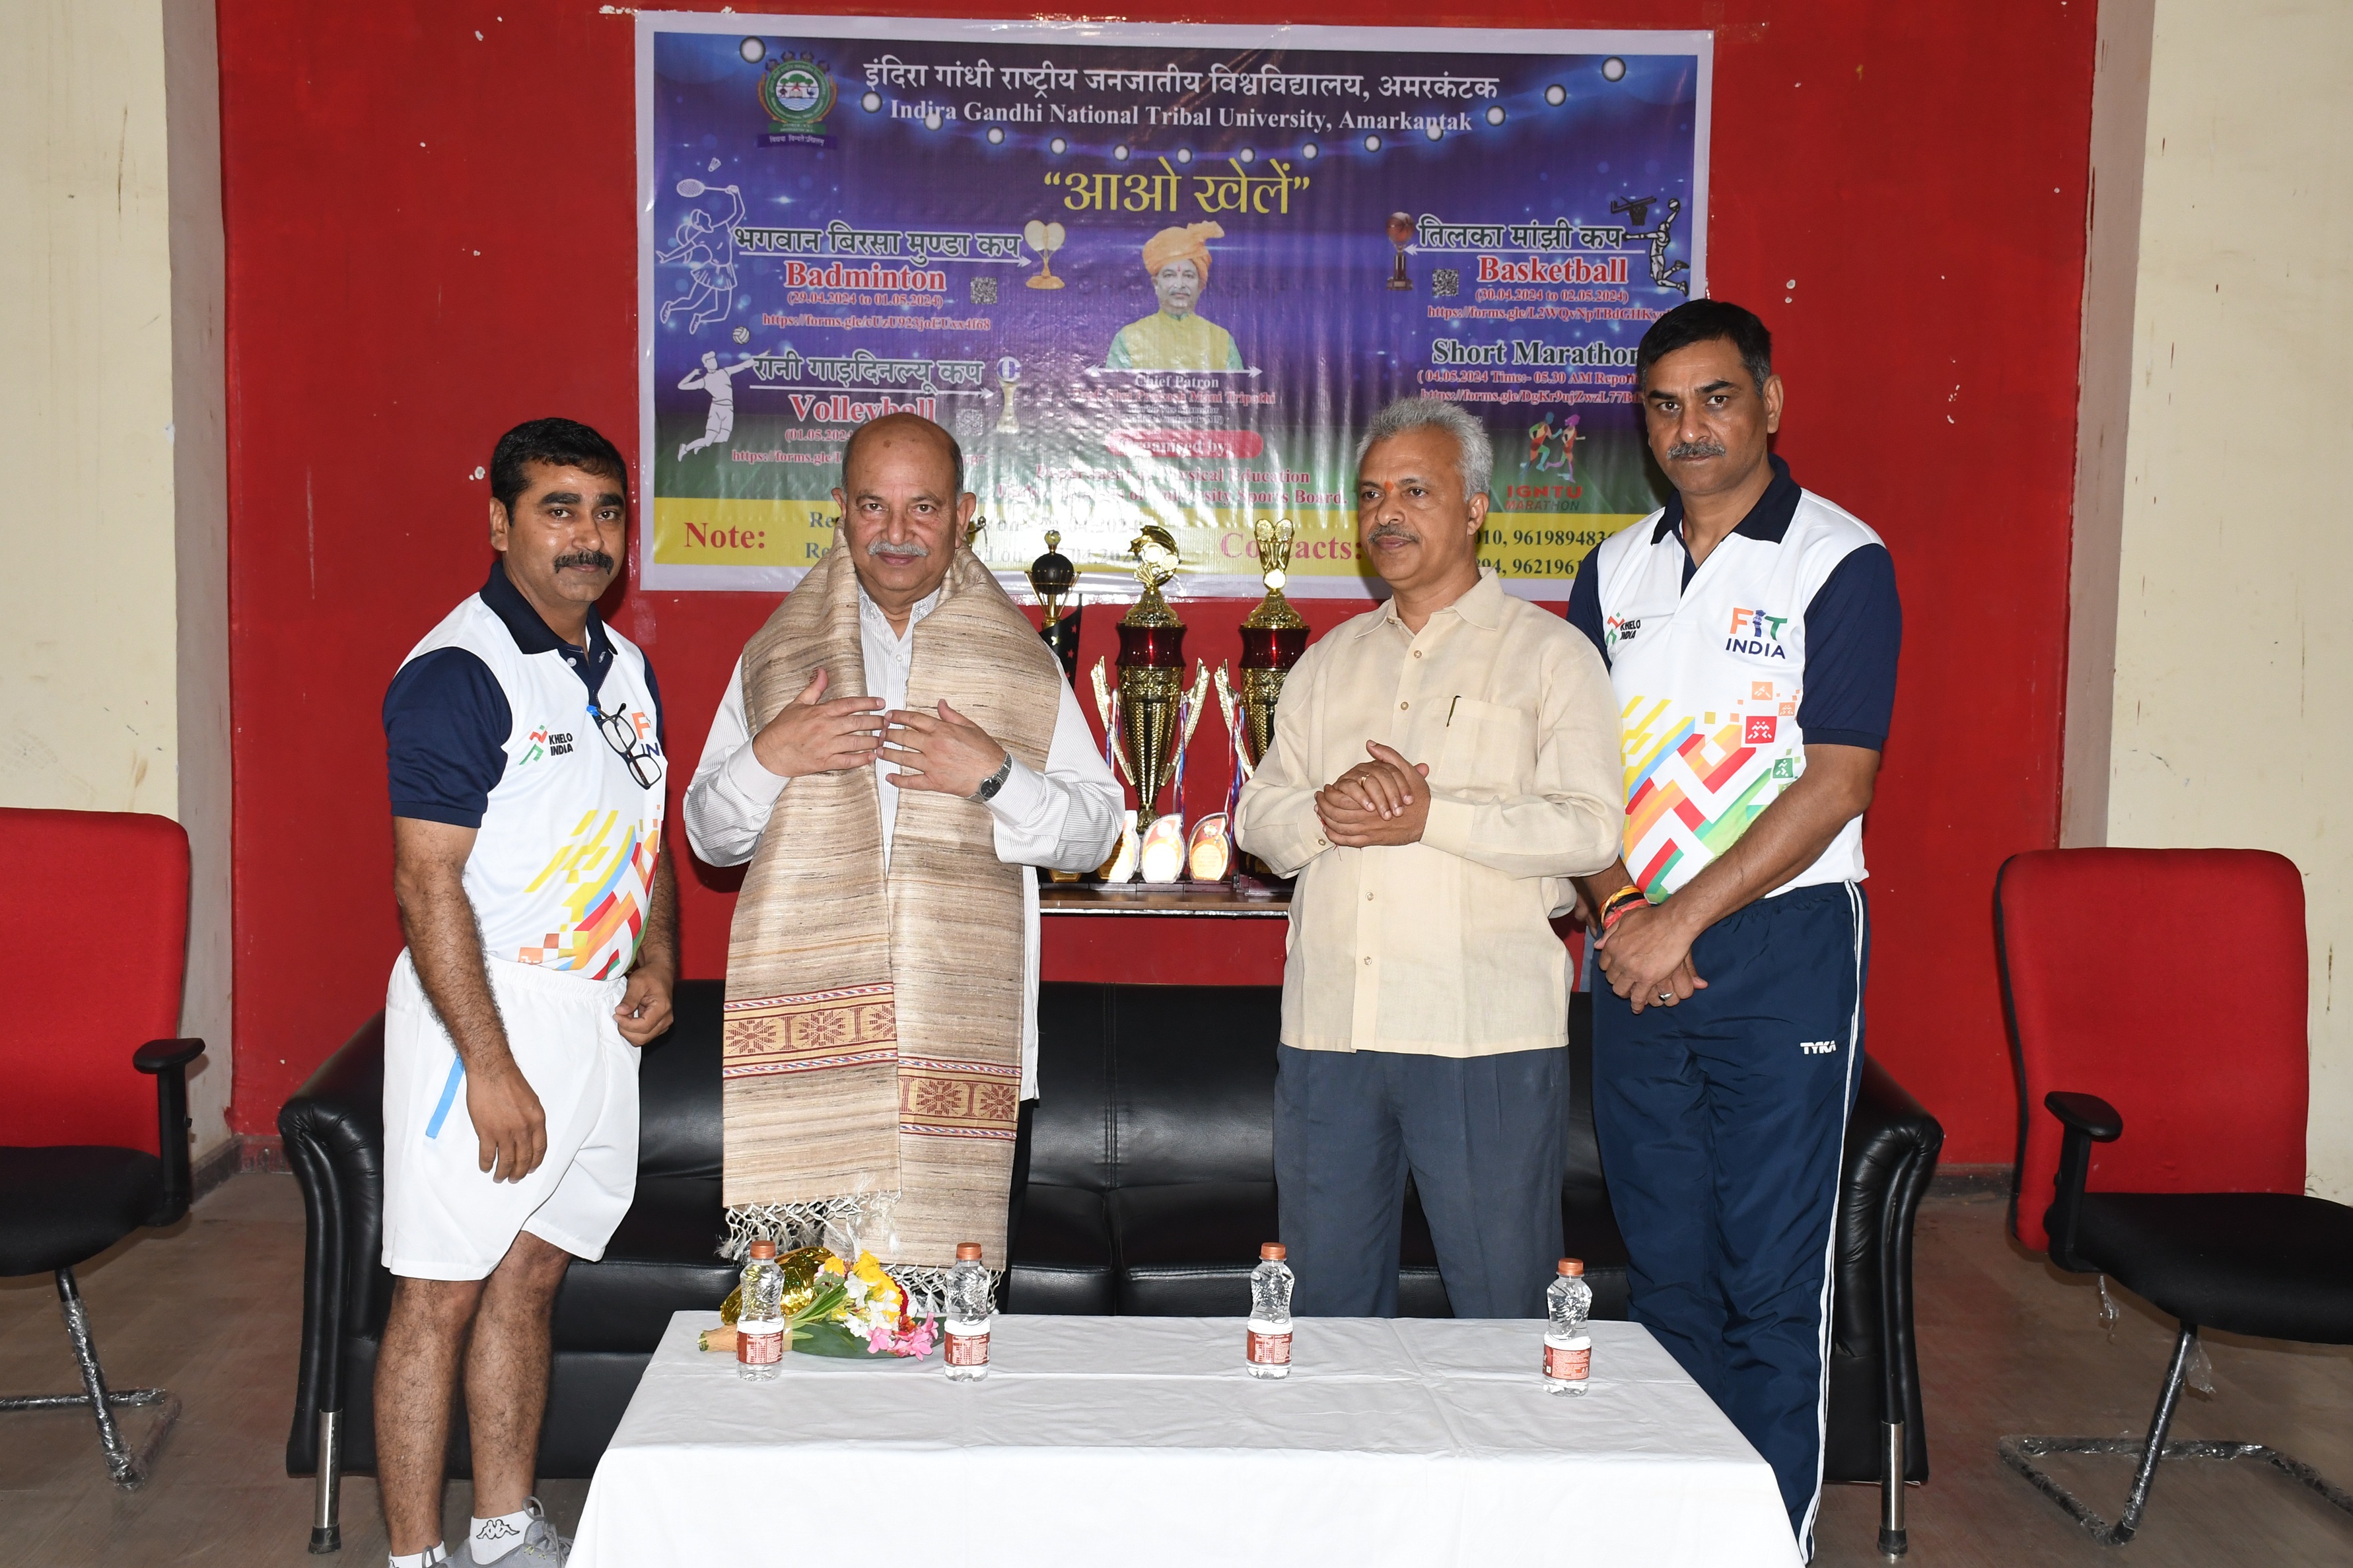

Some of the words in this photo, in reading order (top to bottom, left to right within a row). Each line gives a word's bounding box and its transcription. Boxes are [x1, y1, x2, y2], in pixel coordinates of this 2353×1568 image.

[863, 55, 929, 90] इंदिरा
[934, 58, 994, 89] गांधी
[1000, 60, 1078, 98] राष्ट्रीय
[1083, 63, 1203, 93] जनजातीय
[1208, 63, 1370, 102] विश्वविद्यालय,
[1378, 71, 1500, 99] अमरकंटक
[890, 100, 957, 120] Indira
[964, 100, 1042, 122] Gandhi
[1049, 104, 1138, 125] National
[1146, 106, 1211, 126] Tribal
[1219, 108, 1332, 133] University,
[1339, 110, 1472, 131] Amarkantak
[1044, 156, 1182, 211] “आओ
[1193, 158, 1310, 214] खेलें”
[1416, 213, 1505, 248] तिलका
[1509, 217, 1574, 251] मांझी
[1578, 224, 1626, 250] कप
[733, 226, 823, 252] भगवान
[827, 219, 903, 255] बिरसा
[905, 231, 972, 266] मुण्डा
[975, 232, 1023, 257] कप
[784, 259, 947, 291] Badminton
[1477, 254, 1629, 285] Basketball
[787, 291, 857, 306] (29.04.2024
[859, 293, 872, 306] to
[874, 294, 944, 310] 01.05.2024)
[1475, 288, 1545, 302] (30.04.2024
[1546, 289, 1559, 302] to
[1561, 290, 1629, 304] 02.05.2024)
[1427, 306, 1671, 323] https://forms.gle/L2WQvNpTBdGHKy
[1432, 339, 1506, 365] Short
[753, 348, 804, 381] रानी
[938, 360, 985, 384] कप
[1134, 375, 1171, 388] Chief
[1175, 376, 1219, 389] Patron
[1425, 370, 1489, 383] 04.05.2024
[1533, 372, 1566, 384] 05.30
[1568, 372, 1593, 384] AM
[1295, 489, 1348, 505] Board.
[1506, 485, 1582, 499] IGNTU
[1504, 500, 1580, 511] MARATHON
[684, 522, 765, 549] Note:
[1221, 532, 1362, 560] Coacts:
[1620, 619, 1641, 631] KHELO
[1725, 638, 1786, 660] INDIA
[548, 733, 573, 745] KHELO
[550, 743, 573, 756] INDIA
[1800, 1040, 1837, 1055] TYKA
